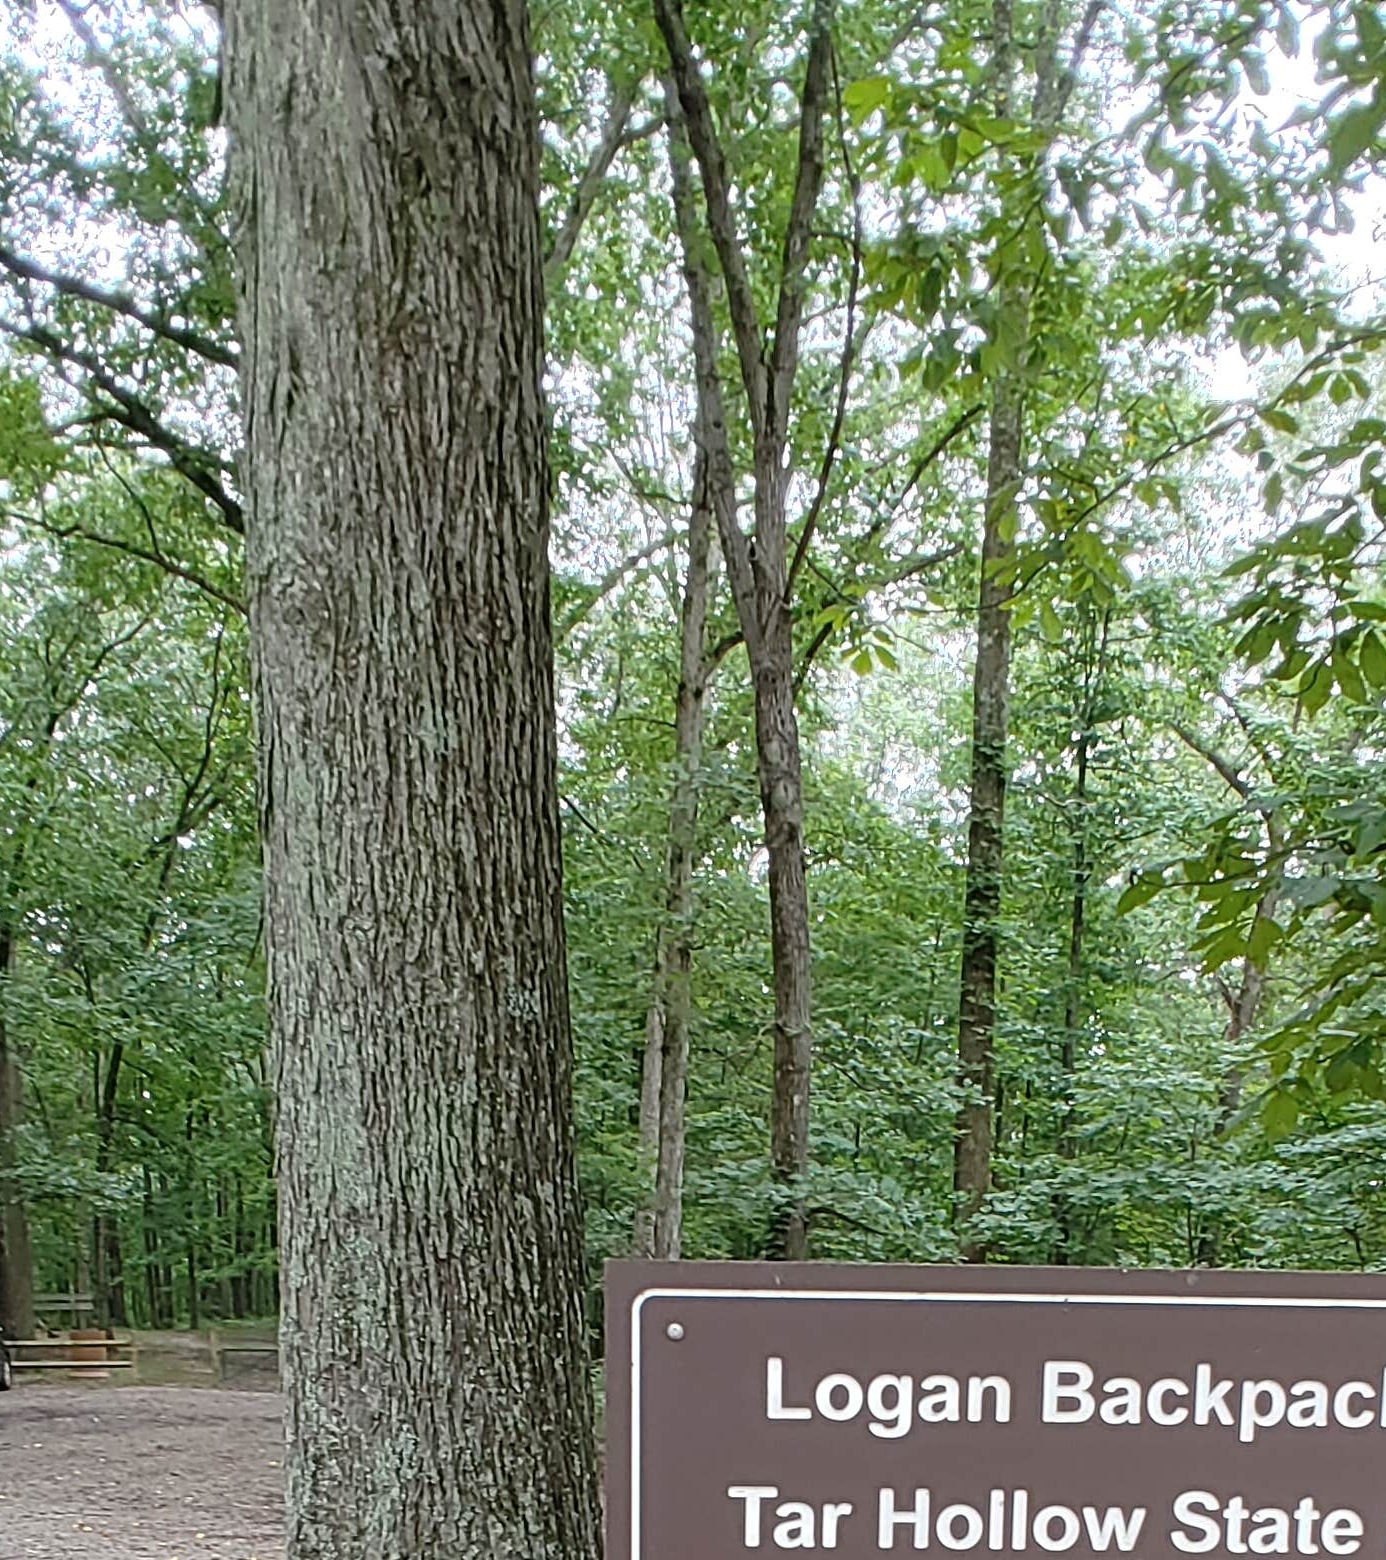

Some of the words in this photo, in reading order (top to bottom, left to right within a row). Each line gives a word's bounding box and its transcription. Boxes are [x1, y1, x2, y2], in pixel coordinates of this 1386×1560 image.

[765, 1356, 1012, 1440] Logan
[726, 1484, 854, 1550] Tar
[877, 1486, 1148, 1553] Hollow
[1169, 1489, 1365, 1556] State
